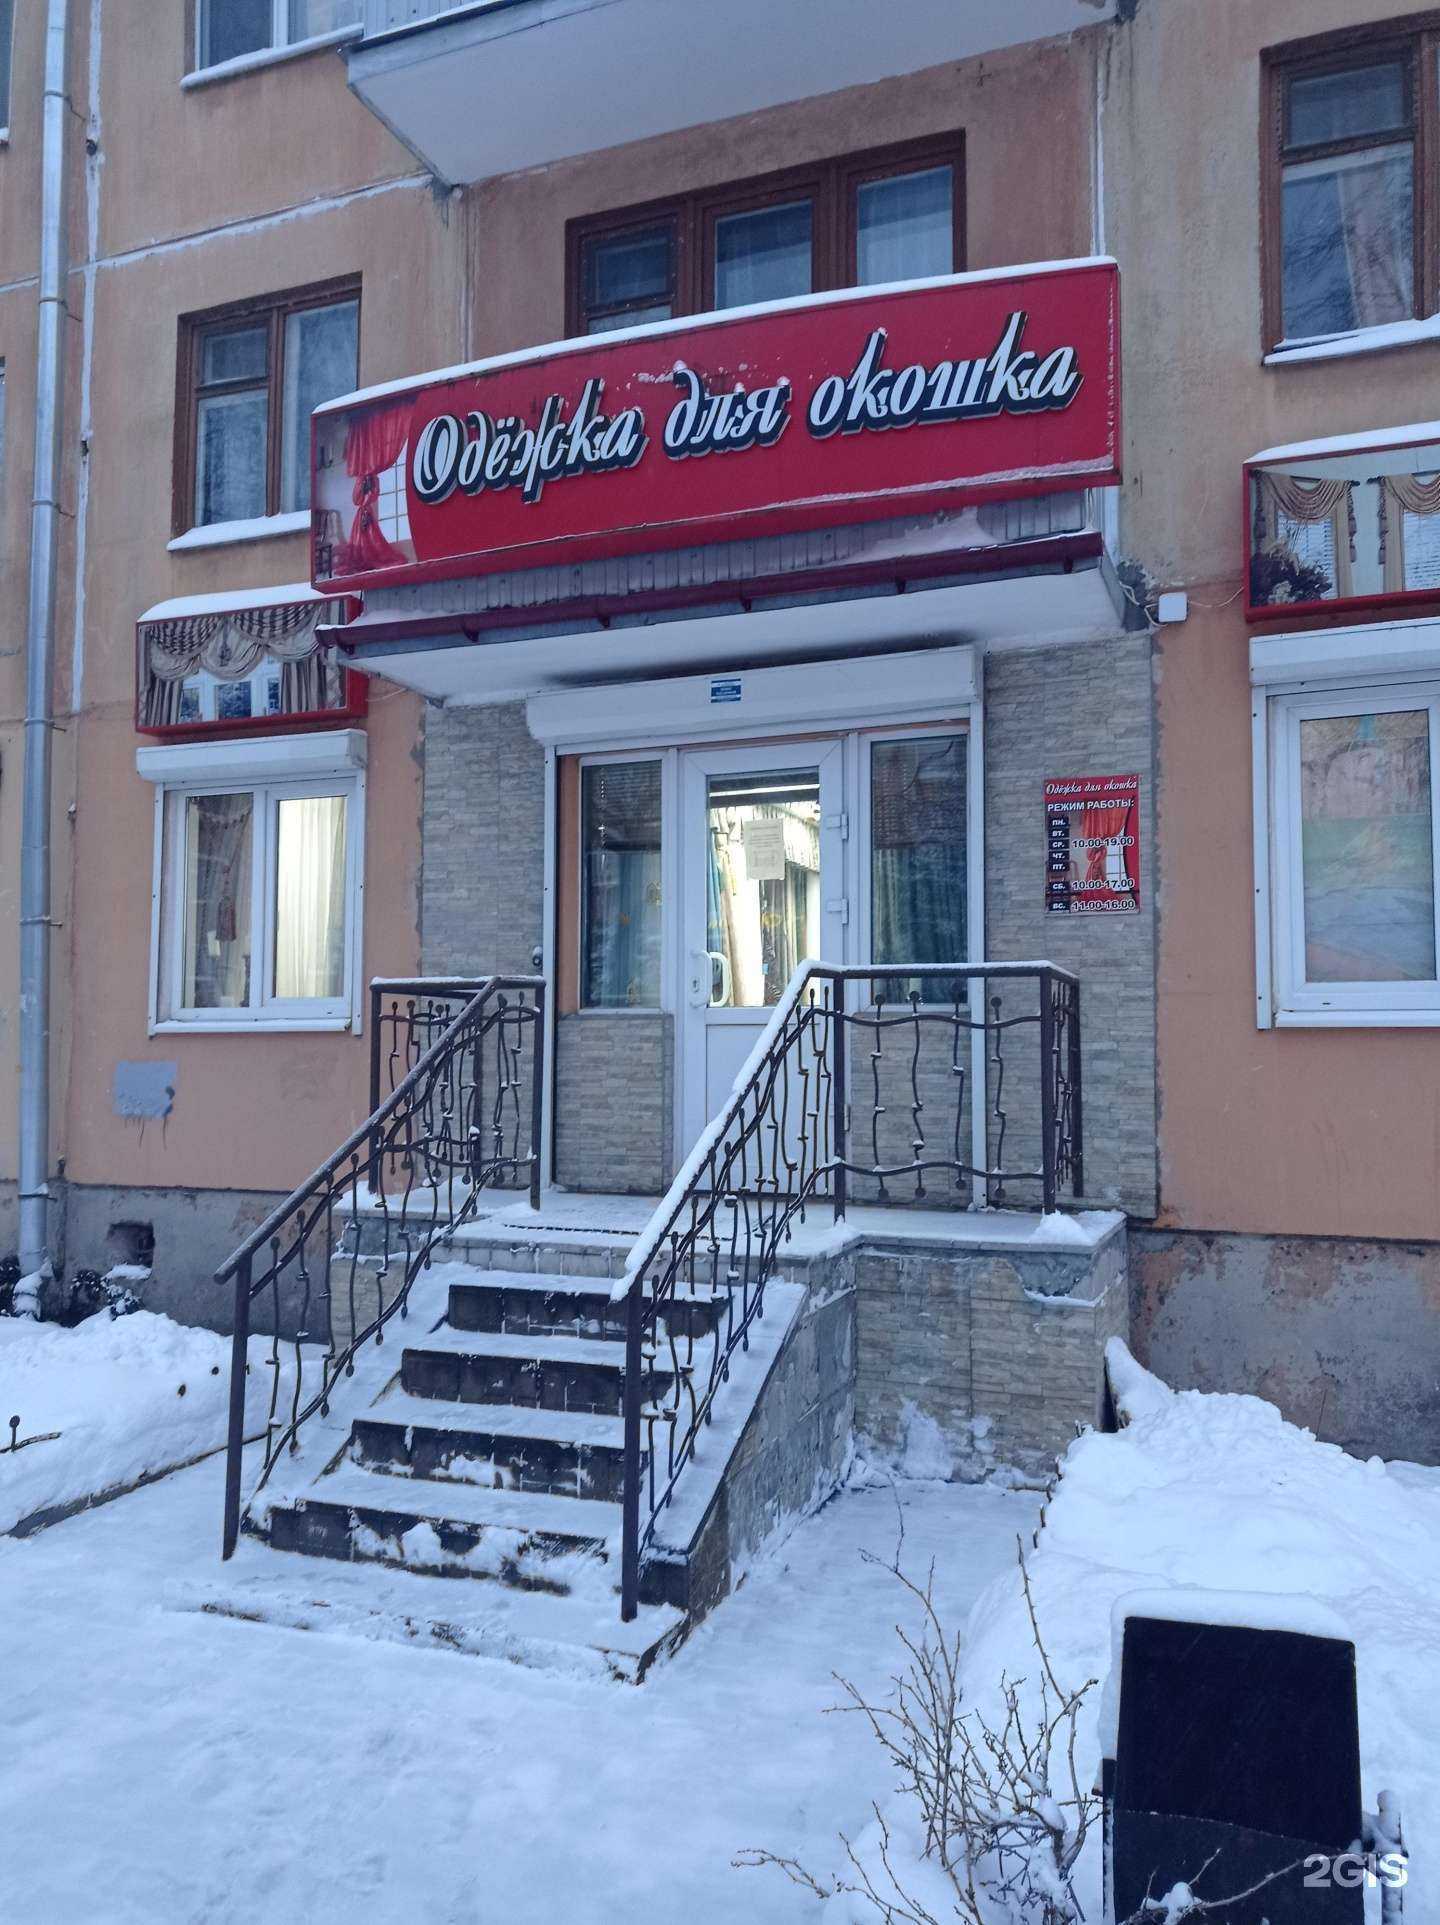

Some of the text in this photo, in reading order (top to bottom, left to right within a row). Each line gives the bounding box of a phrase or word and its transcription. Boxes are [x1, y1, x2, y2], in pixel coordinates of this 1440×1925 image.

[411, 311, 1085, 505] Одёжка для окошка
[1047, 799, 1134, 812] РЕЖИМ РАБОТЫ:
[1072, 837, 1134, 848] 10.00-19.00
[1072, 879, 1134, 890] 10.00-17.00
[1072, 900, 1135, 911] 11.00-16.00
